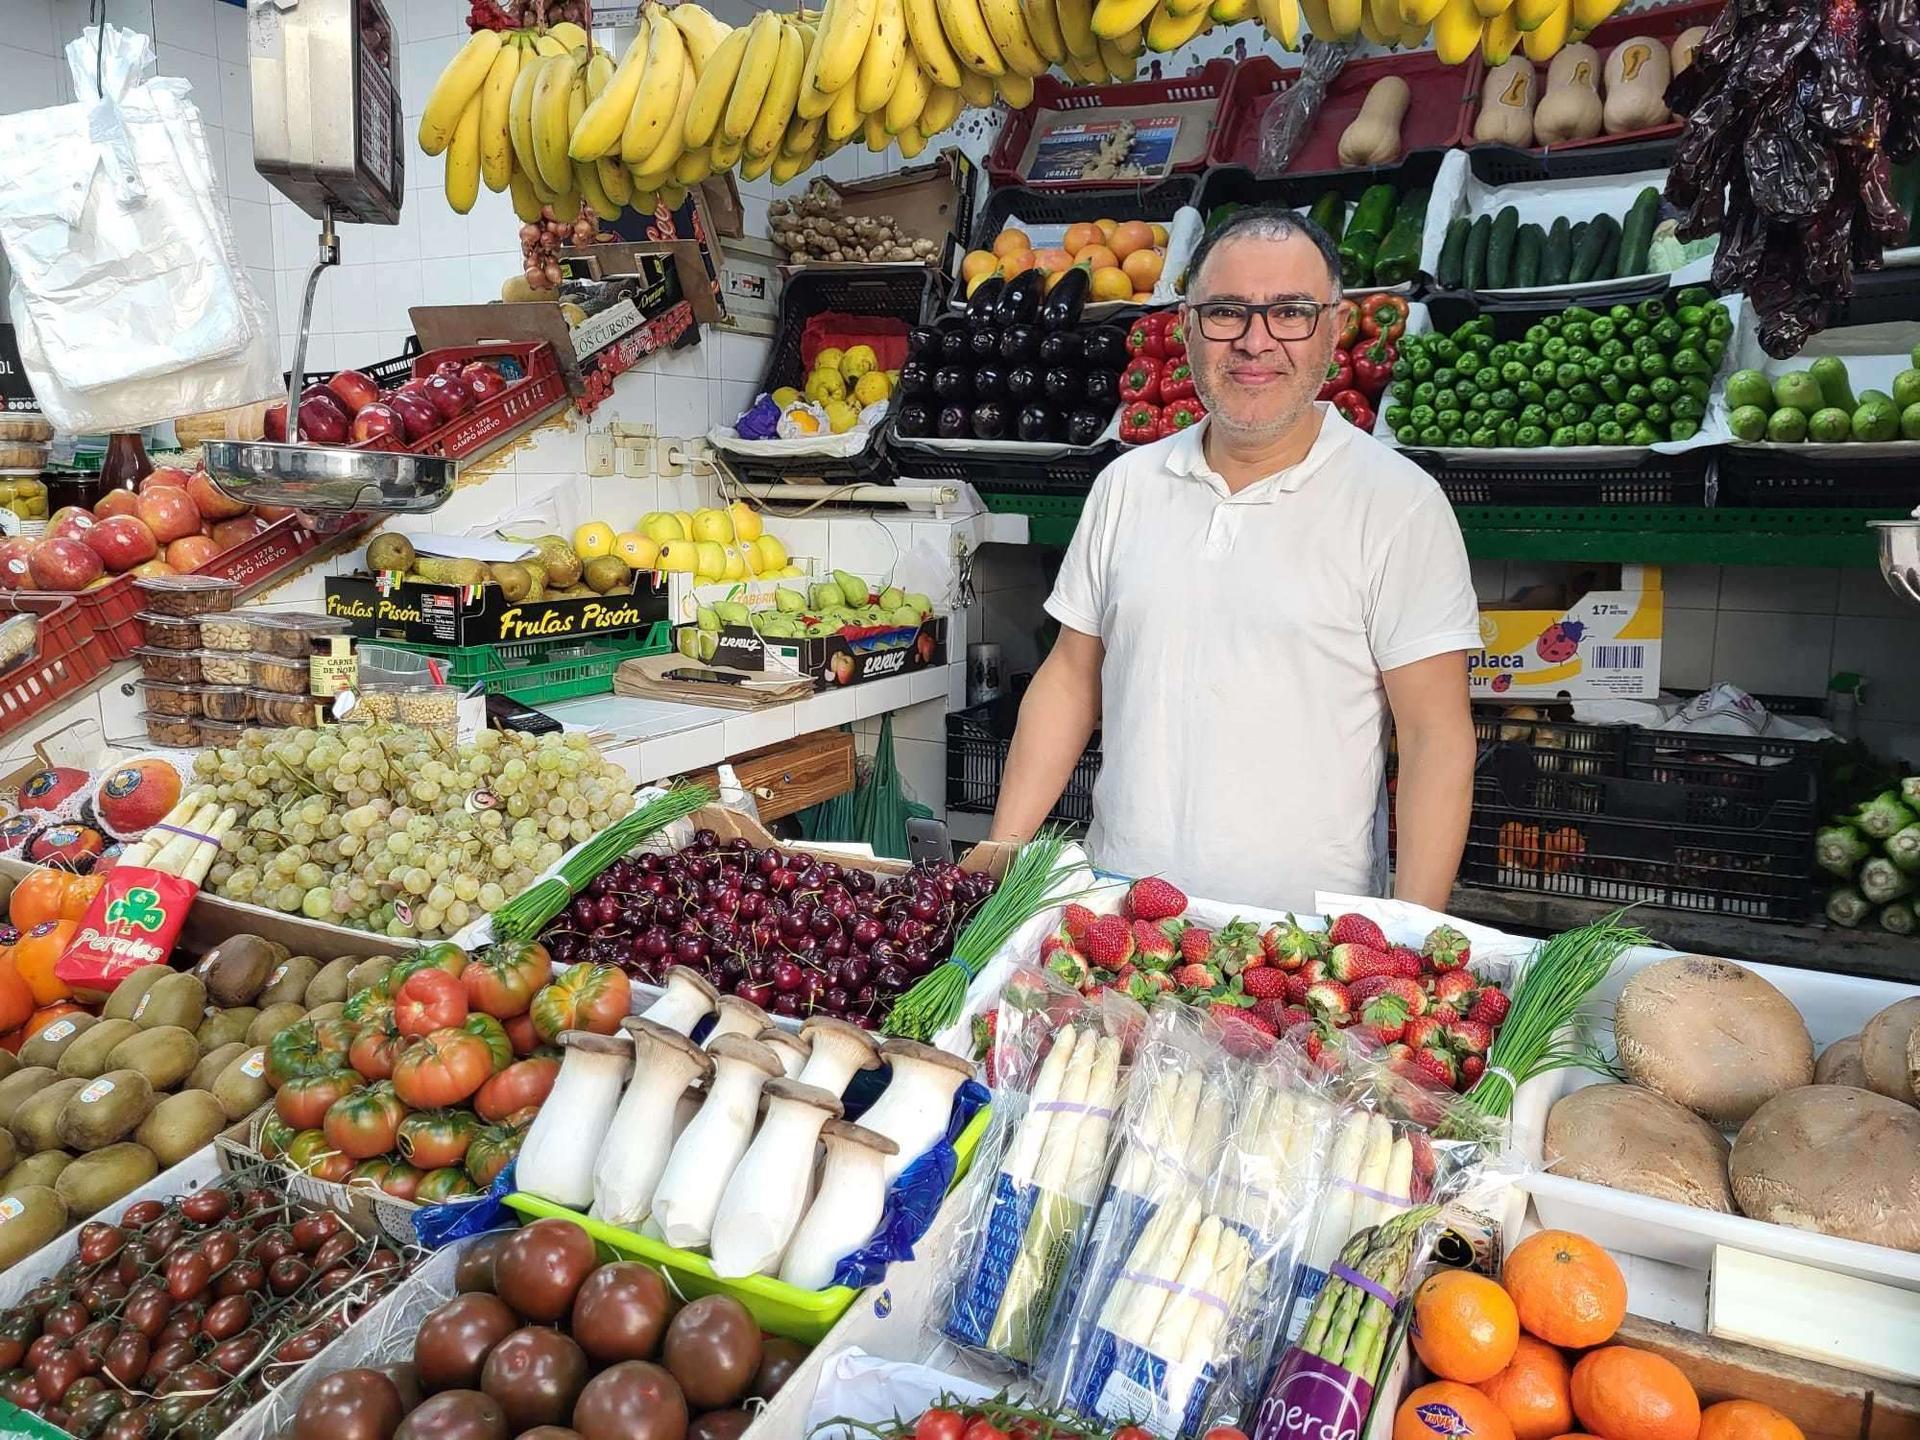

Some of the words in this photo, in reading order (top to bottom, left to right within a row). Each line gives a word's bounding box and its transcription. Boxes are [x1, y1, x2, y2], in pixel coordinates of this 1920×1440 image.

[594, 311, 635, 343] CURSOS
[452, 433, 476, 451] CAMPO
[477, 419, 500, 437] NUEVO
[227, 559, 253, 576] S.A.T.
[254, 545, 274, 560] 1278
[228, 566, 254, 583] AMPO
[255, 547, 287, 569] NUEVO
[326, 594, 374, 619] Frutas
[377, 600, 422, 623] Pisón
[500, 608, 575, 640] Frutas
[581, 602, 641, 630] Pisón
[1592, 604, 1608, 615] 17
[327, 658, 353, 666] CARNE
[1468, 650, 1524, 673] placa
[72, 927, 164, 962] Perales
